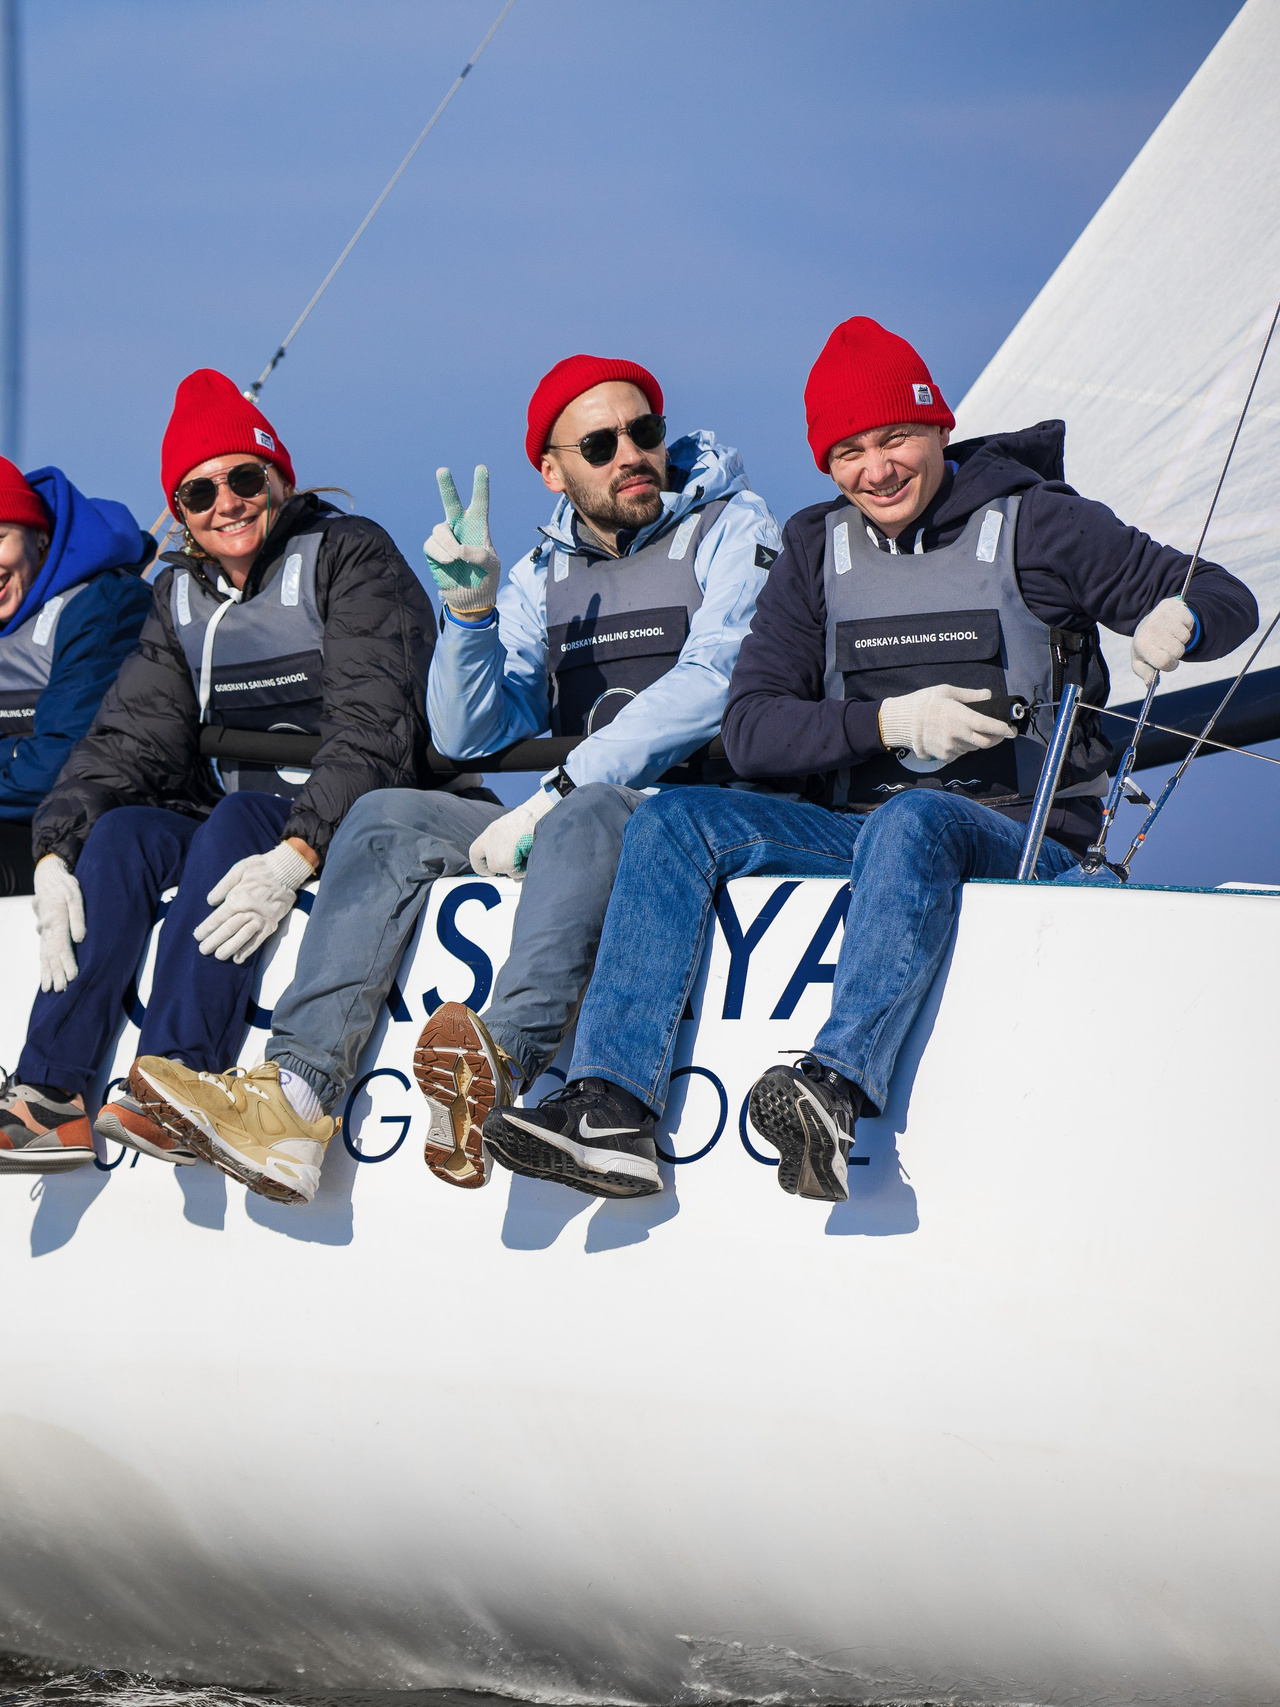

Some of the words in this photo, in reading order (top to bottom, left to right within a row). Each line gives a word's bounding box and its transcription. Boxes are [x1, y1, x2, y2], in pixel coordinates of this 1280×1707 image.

[561, 636, 597, 652] GORSKAYA
[598, 631, 628, 644] SAILING
[629, 627, 664, 639] SCHOOL
[854, 636, 899, 649] GORSKAYA
[900, 633, 936, 645] SAILING
[938, 631, 978, 642] SCHOOL
[214, 682, 249, 692] GORSKAYA
[248, 678, 276, 690] SAILING
[275, 672, 308, 685] SCHOOL
